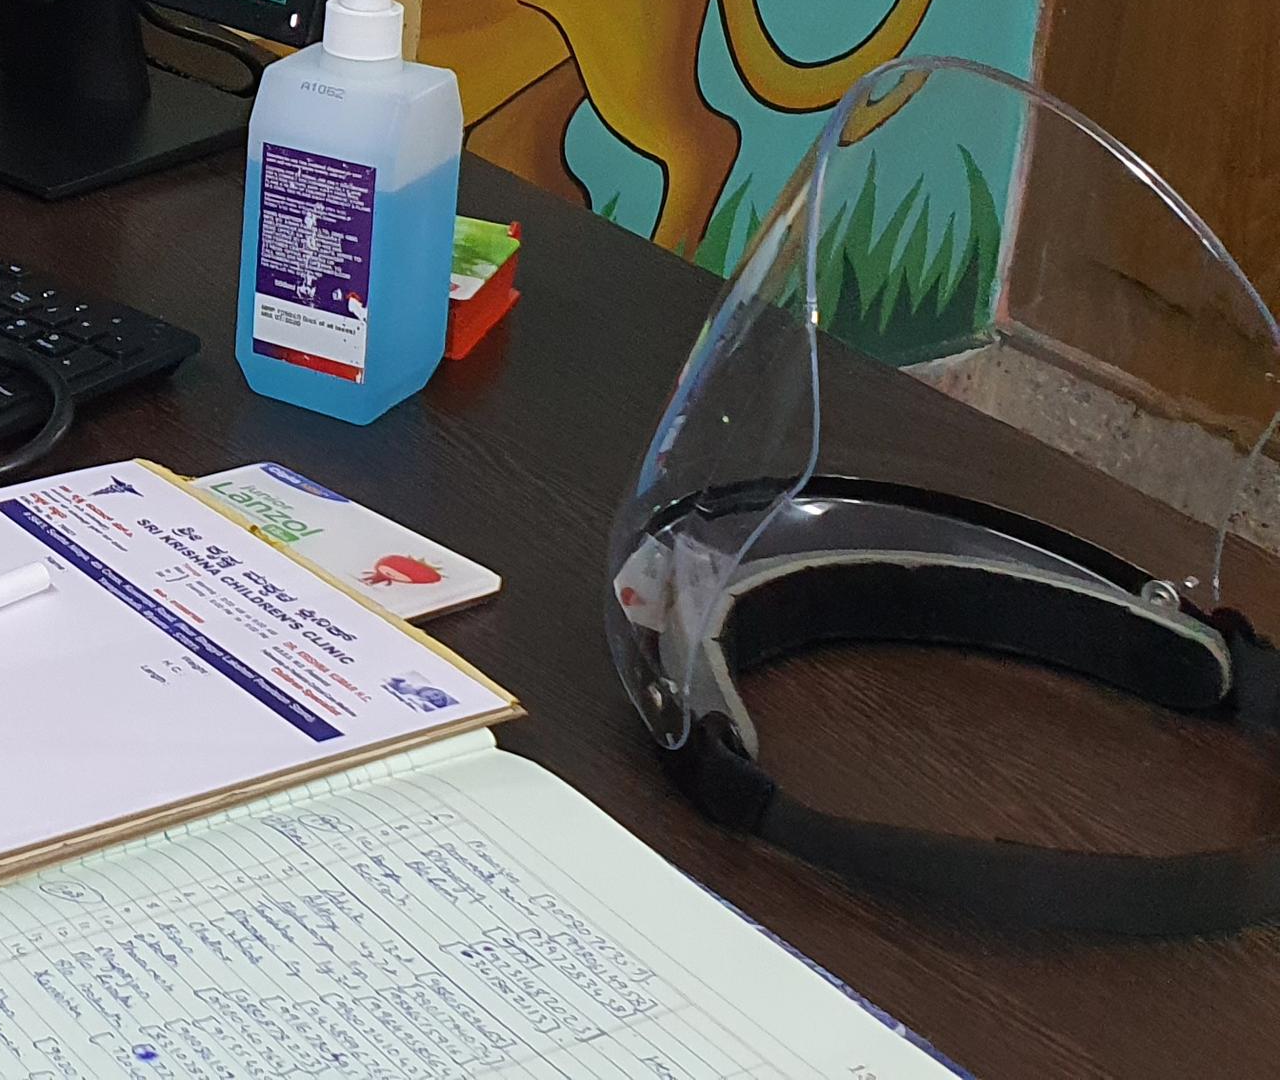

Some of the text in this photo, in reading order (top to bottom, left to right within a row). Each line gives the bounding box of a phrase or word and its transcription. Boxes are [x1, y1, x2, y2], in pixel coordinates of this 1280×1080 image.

[208, 481, 327, 542] Lanzol
[137, 519, 163, 535] SRI
[160, 536, 221, 575] KRISHNA
[221, 576, 303, 630] CHILDREN'S
[302, 631, 354, 664] CLINIC
[140, 665, 166, 683] Length
[182, 656, 208, 674] Weight
[271, 667, 342, 716] Children Specialist
